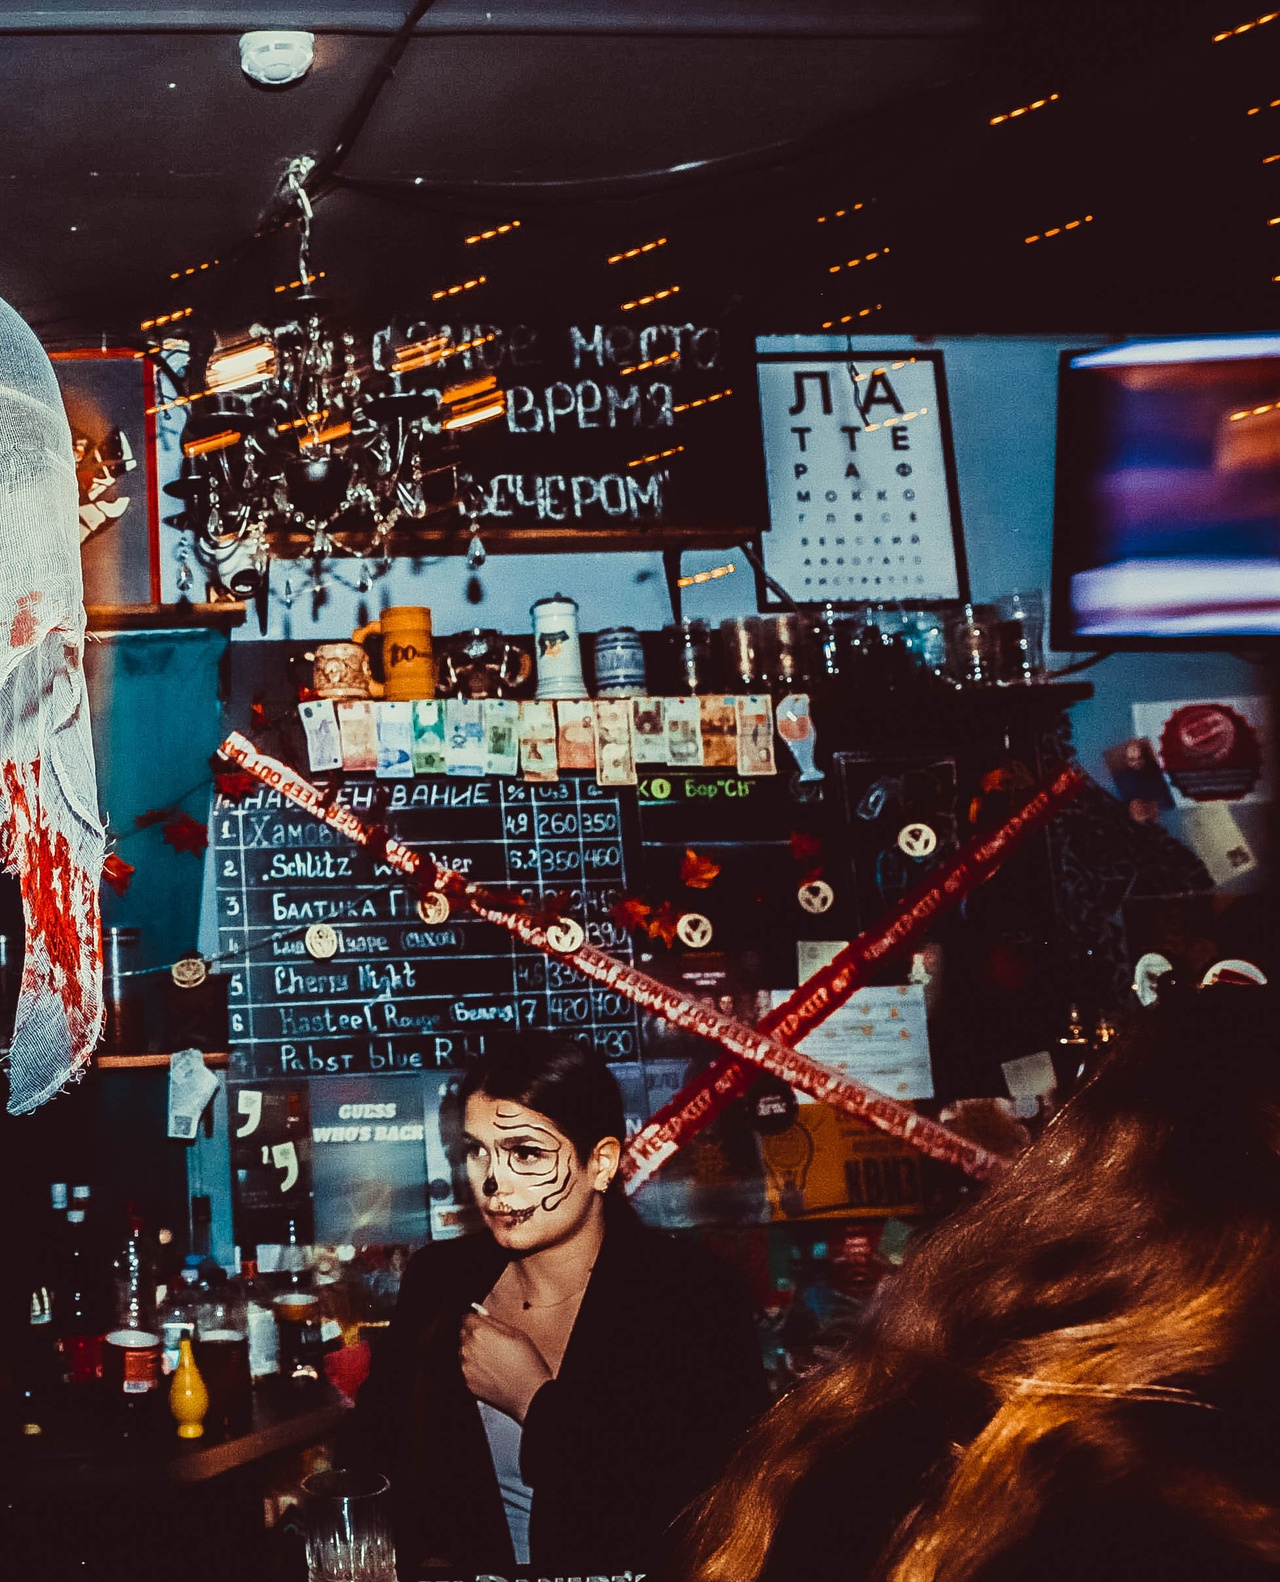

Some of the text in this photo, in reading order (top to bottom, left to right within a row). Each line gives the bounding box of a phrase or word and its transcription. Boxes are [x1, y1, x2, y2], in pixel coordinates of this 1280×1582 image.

[538, 812, 577, 836] 260
[582, 812, 617, 833] 350
[223, 861, 239, 877] 2
[540, 848, 580, 872] 350
[226, 896, 240, 916] 3
[230, 974, 244, 997] 5
[231, 1013, 244, 1032] 6
[521, 999, 537, 1025] 7
[370, 1040, 424, 1071] blue
[338, 1103, 397, 1119] GUESS
[373, 1125, 424, 1141] BACK
